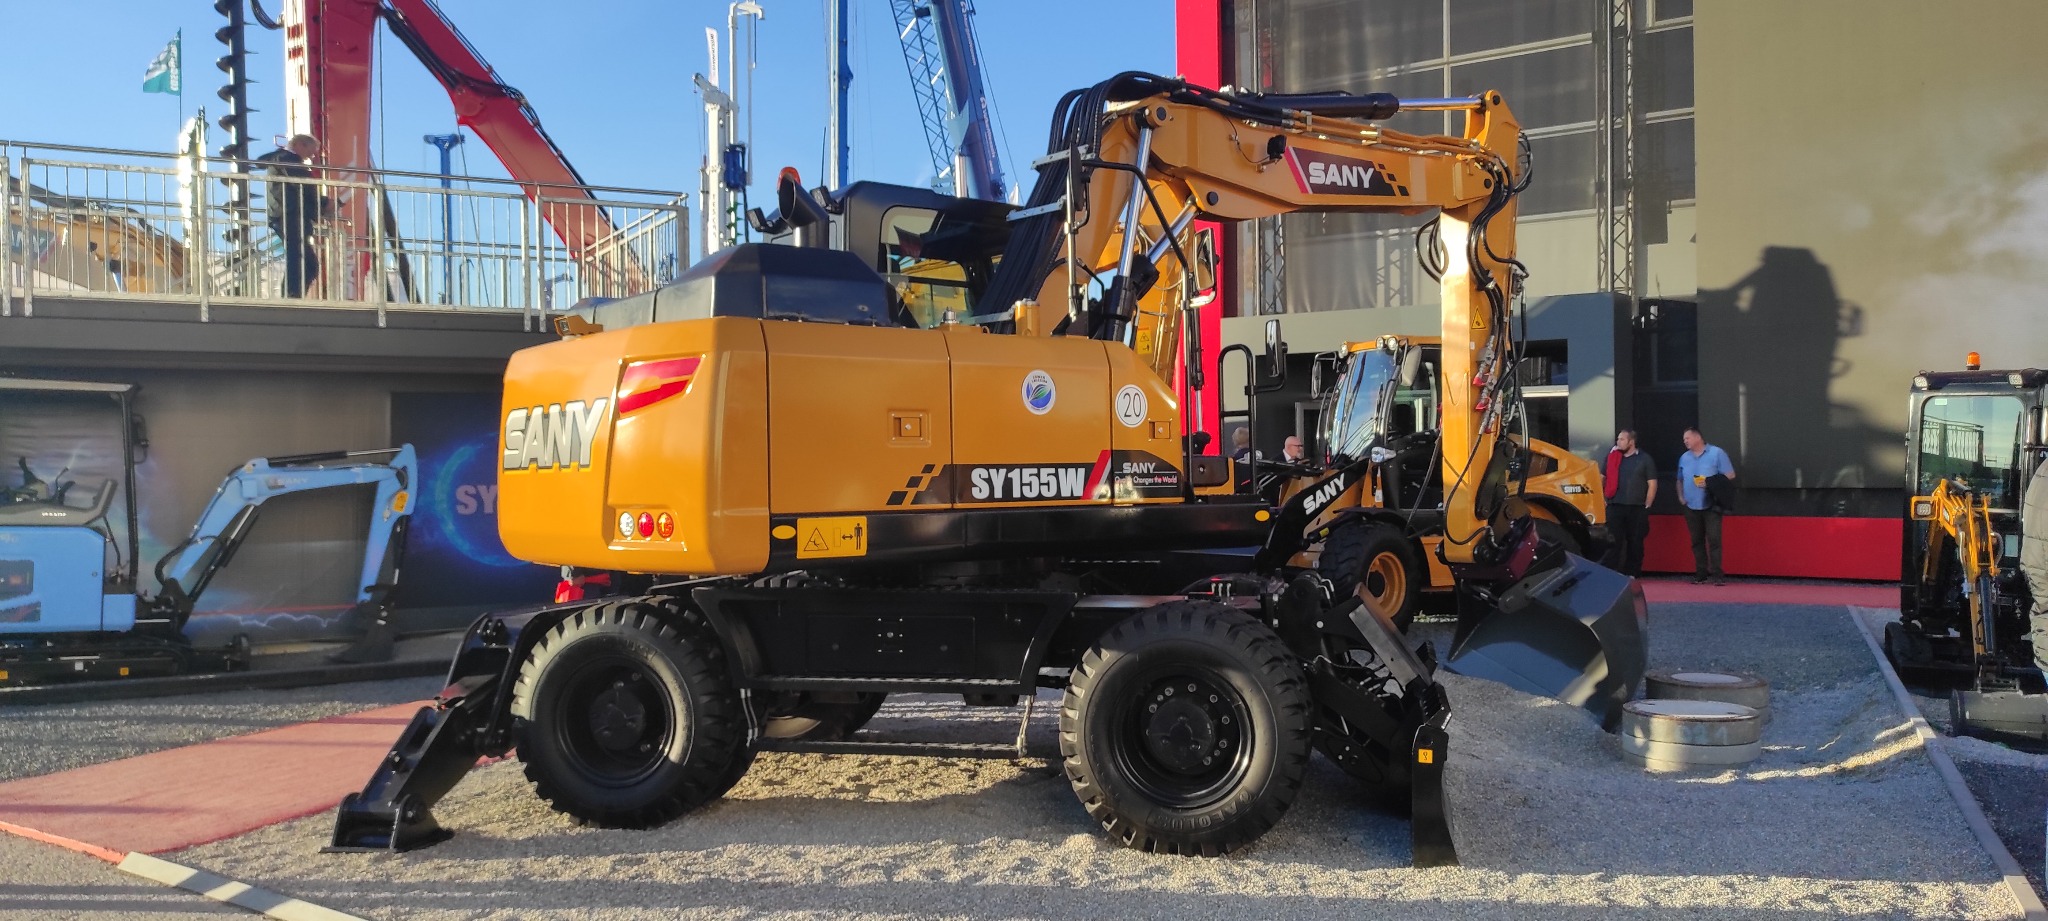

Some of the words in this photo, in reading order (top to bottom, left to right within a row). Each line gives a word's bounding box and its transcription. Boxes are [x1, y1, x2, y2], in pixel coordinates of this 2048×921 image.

[1308, 161, 1374, 189] SANY
[1123, 392, 1142, 418] 20
[503, 397, 608, 471] SANY
[1122, 462, 1156, 474] SANY
[1133, 475, 1154, 485] Changes
[1154, 475, 1162, 483] the
[1162, 475, 1178, 484] World
[970, 467, 1086, 500] SY155W
[1303, 472, 1345, 516] SANY
